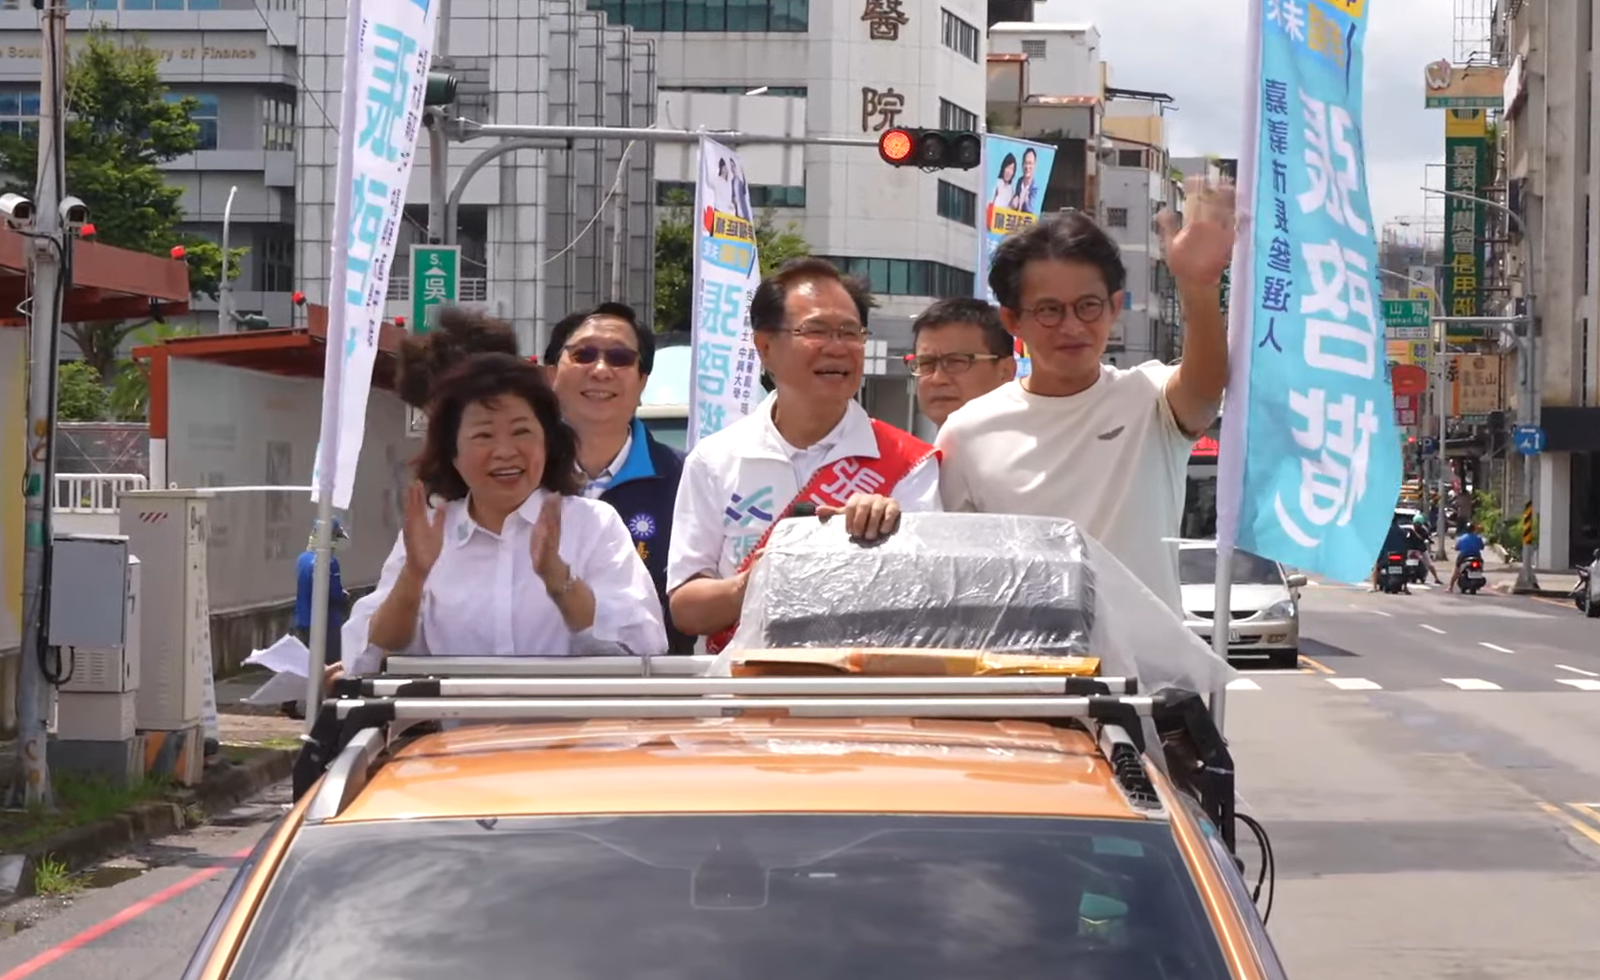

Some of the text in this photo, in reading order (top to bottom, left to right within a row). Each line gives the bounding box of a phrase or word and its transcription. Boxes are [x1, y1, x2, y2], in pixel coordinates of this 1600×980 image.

[202, 46, 257, 60] Finance
[861, 0, 909, 132] 醫院
[810, 457, 886, 506] 張
